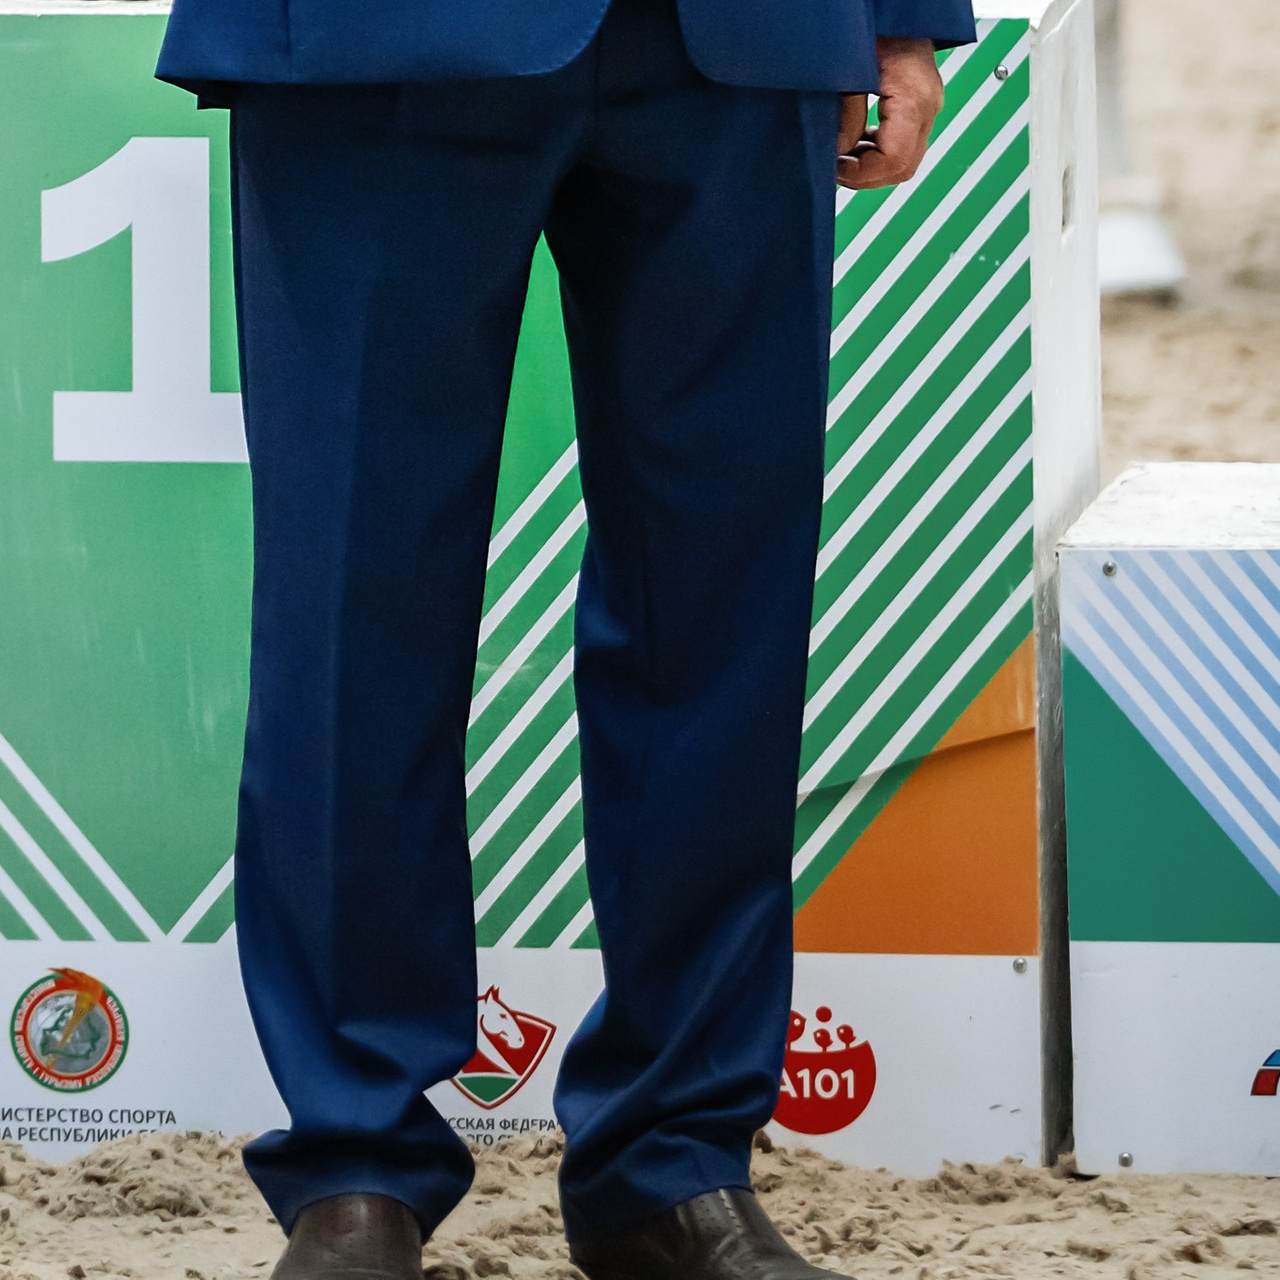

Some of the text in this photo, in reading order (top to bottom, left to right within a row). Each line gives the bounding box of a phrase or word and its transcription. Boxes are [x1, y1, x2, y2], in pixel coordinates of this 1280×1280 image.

[41, 136, 250, 463] 1
[108, 1109, 177, 1124] СПОРТА
[445, 1117, 557, 1134] ССКАЯ ФЕДЕРА
